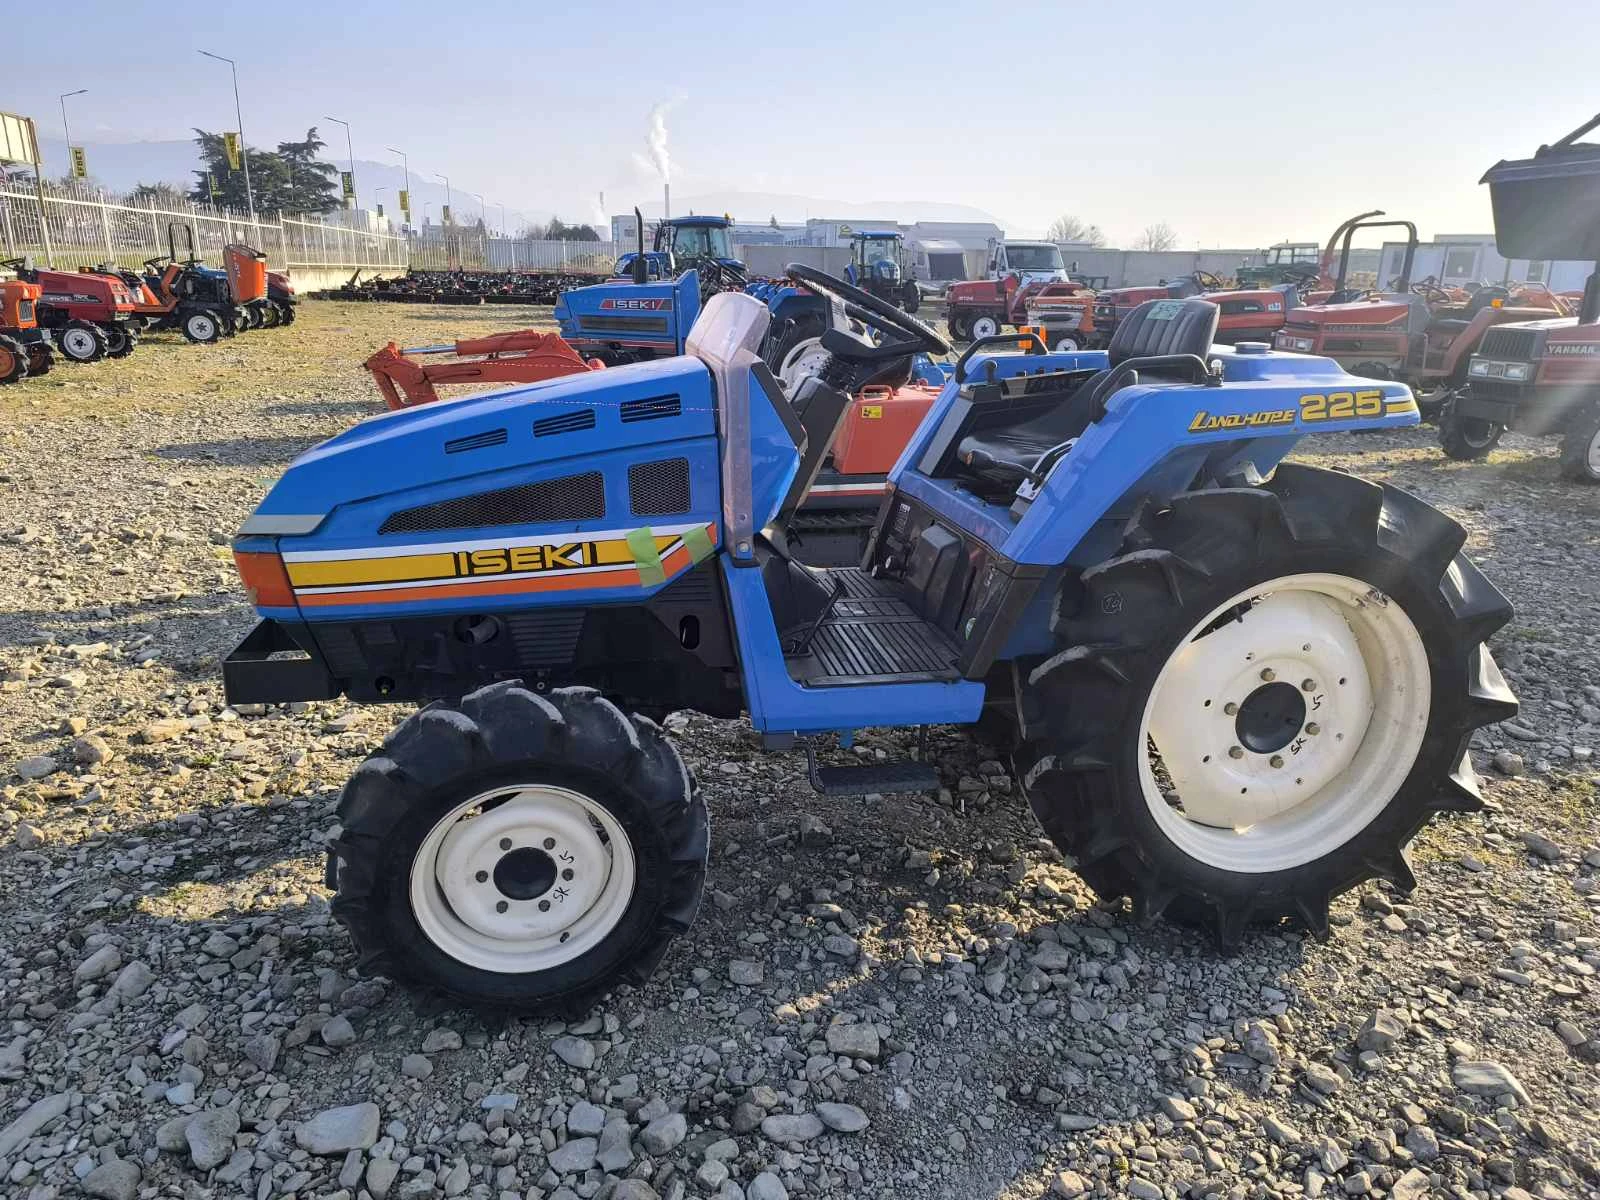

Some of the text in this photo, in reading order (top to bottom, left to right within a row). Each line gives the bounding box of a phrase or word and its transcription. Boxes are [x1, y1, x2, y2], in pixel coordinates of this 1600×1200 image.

[612, 300, 656, 309] ISEKI
[1548, 344, 1596, 355] YANMAR
[1299, 390, 1383, 422] 225
[457, 541, 597, 576] ISEKI
